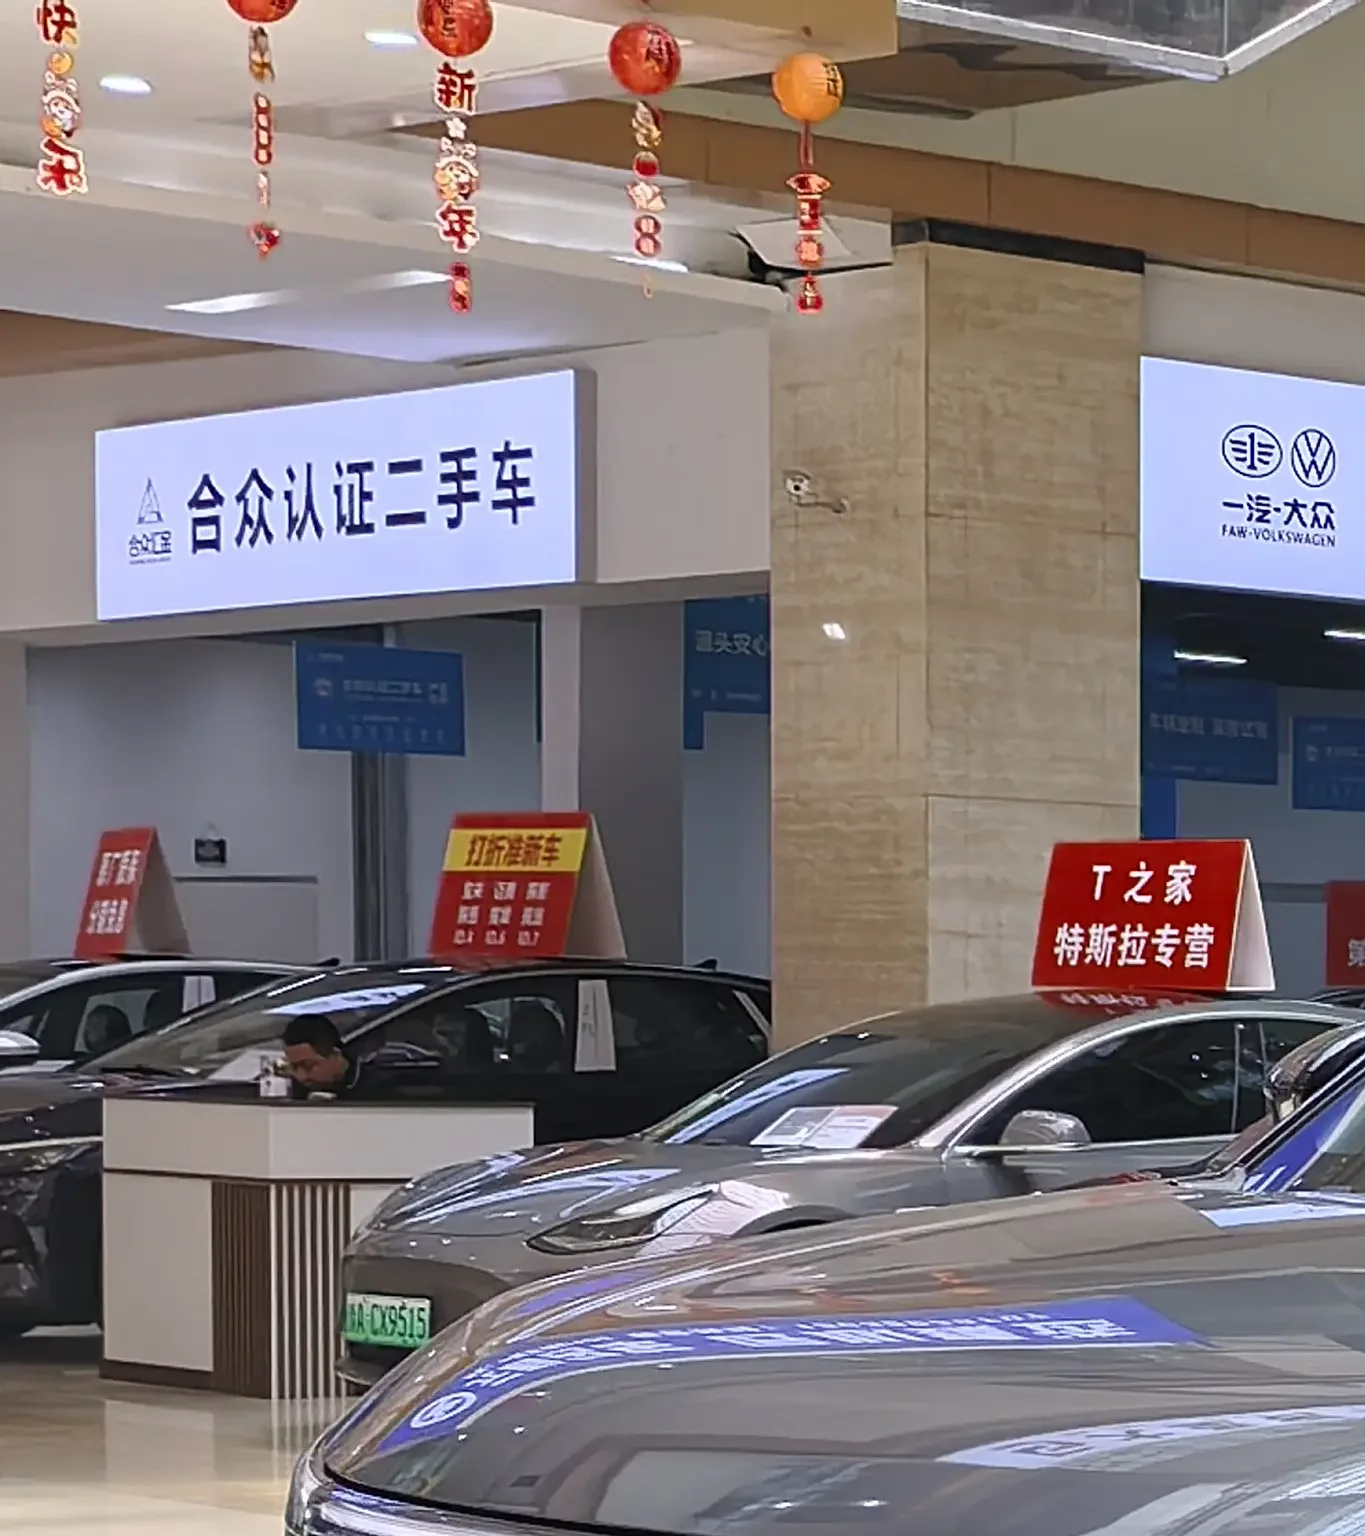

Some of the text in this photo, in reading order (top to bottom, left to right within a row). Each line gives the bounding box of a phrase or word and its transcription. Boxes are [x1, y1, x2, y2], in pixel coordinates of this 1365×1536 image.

[186, 439, 536, 555] 合众认证二手车
[1221, 493, 1336, 531] 一汽-大众
[1221, 523, 1336, 548] FAW-VOLKSWAGEN
[1053, 922, 1215, 969] 特斯拉专营
